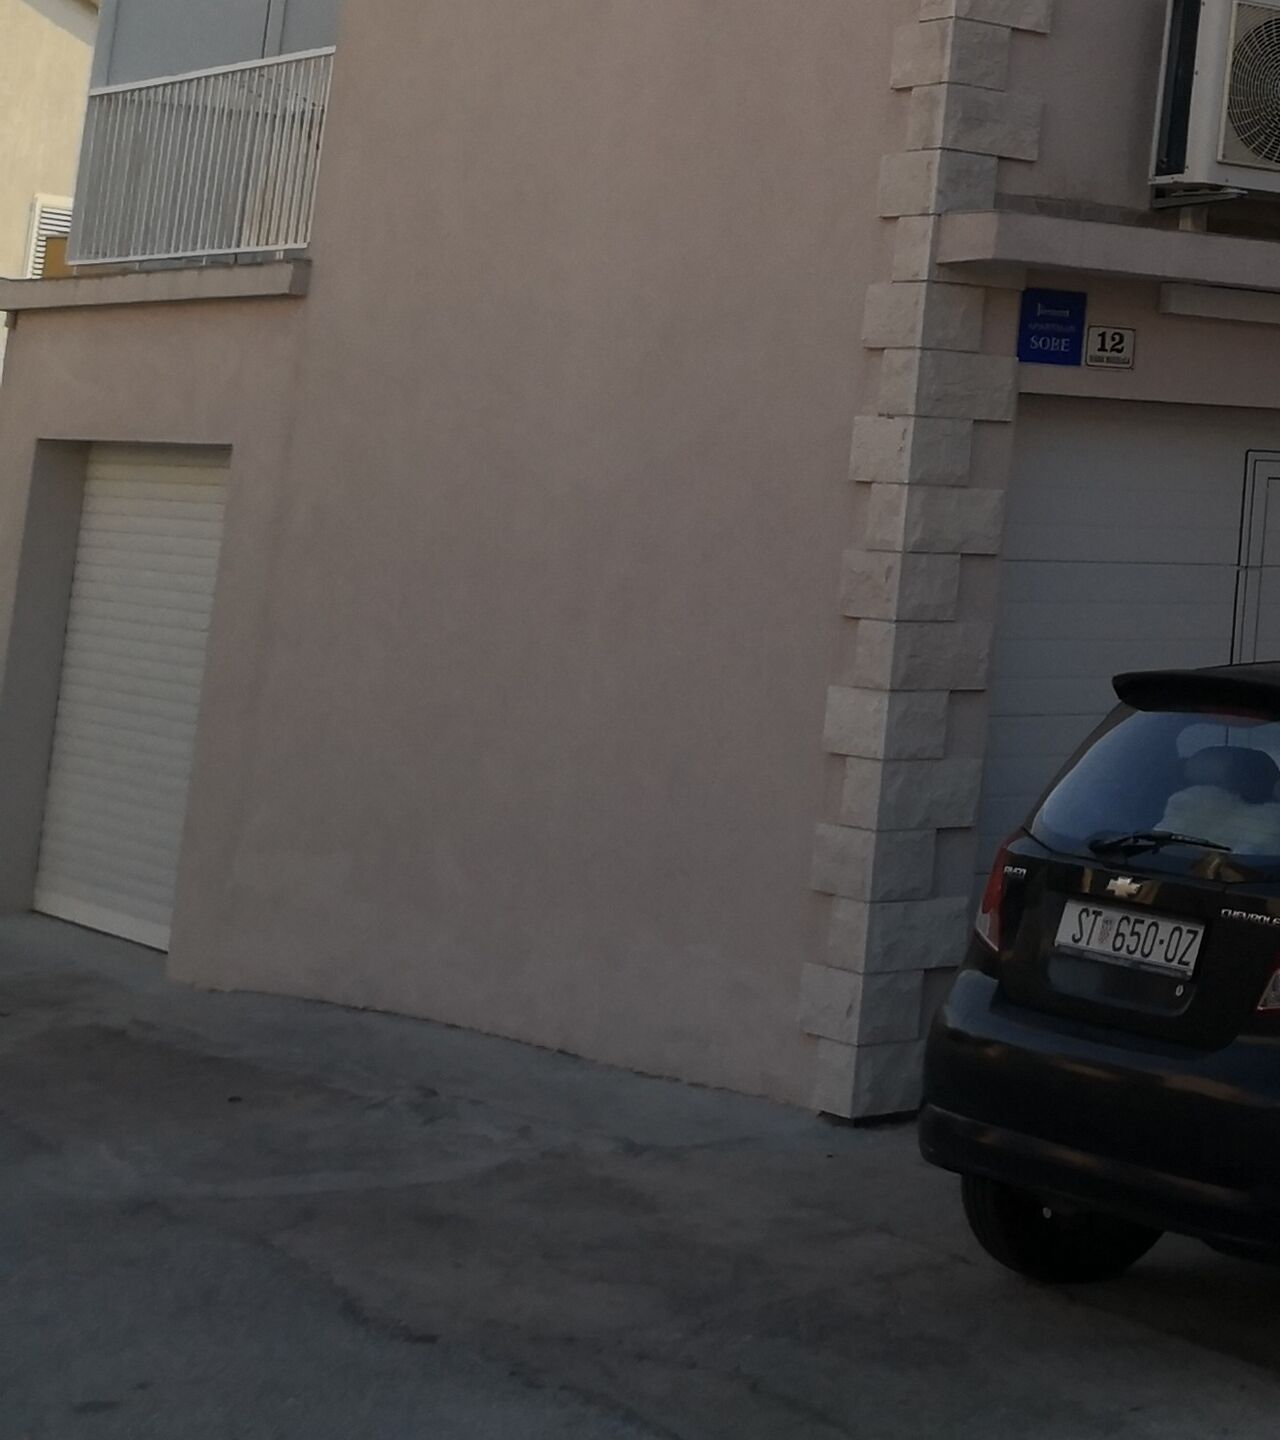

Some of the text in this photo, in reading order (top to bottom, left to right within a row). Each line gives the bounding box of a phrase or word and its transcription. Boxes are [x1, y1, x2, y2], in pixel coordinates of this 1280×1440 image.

[1029, 334, 1071, 352] SOBE
[1097, 331, 1124, 354] 12
[1072, 907, 1102, 946] ST
